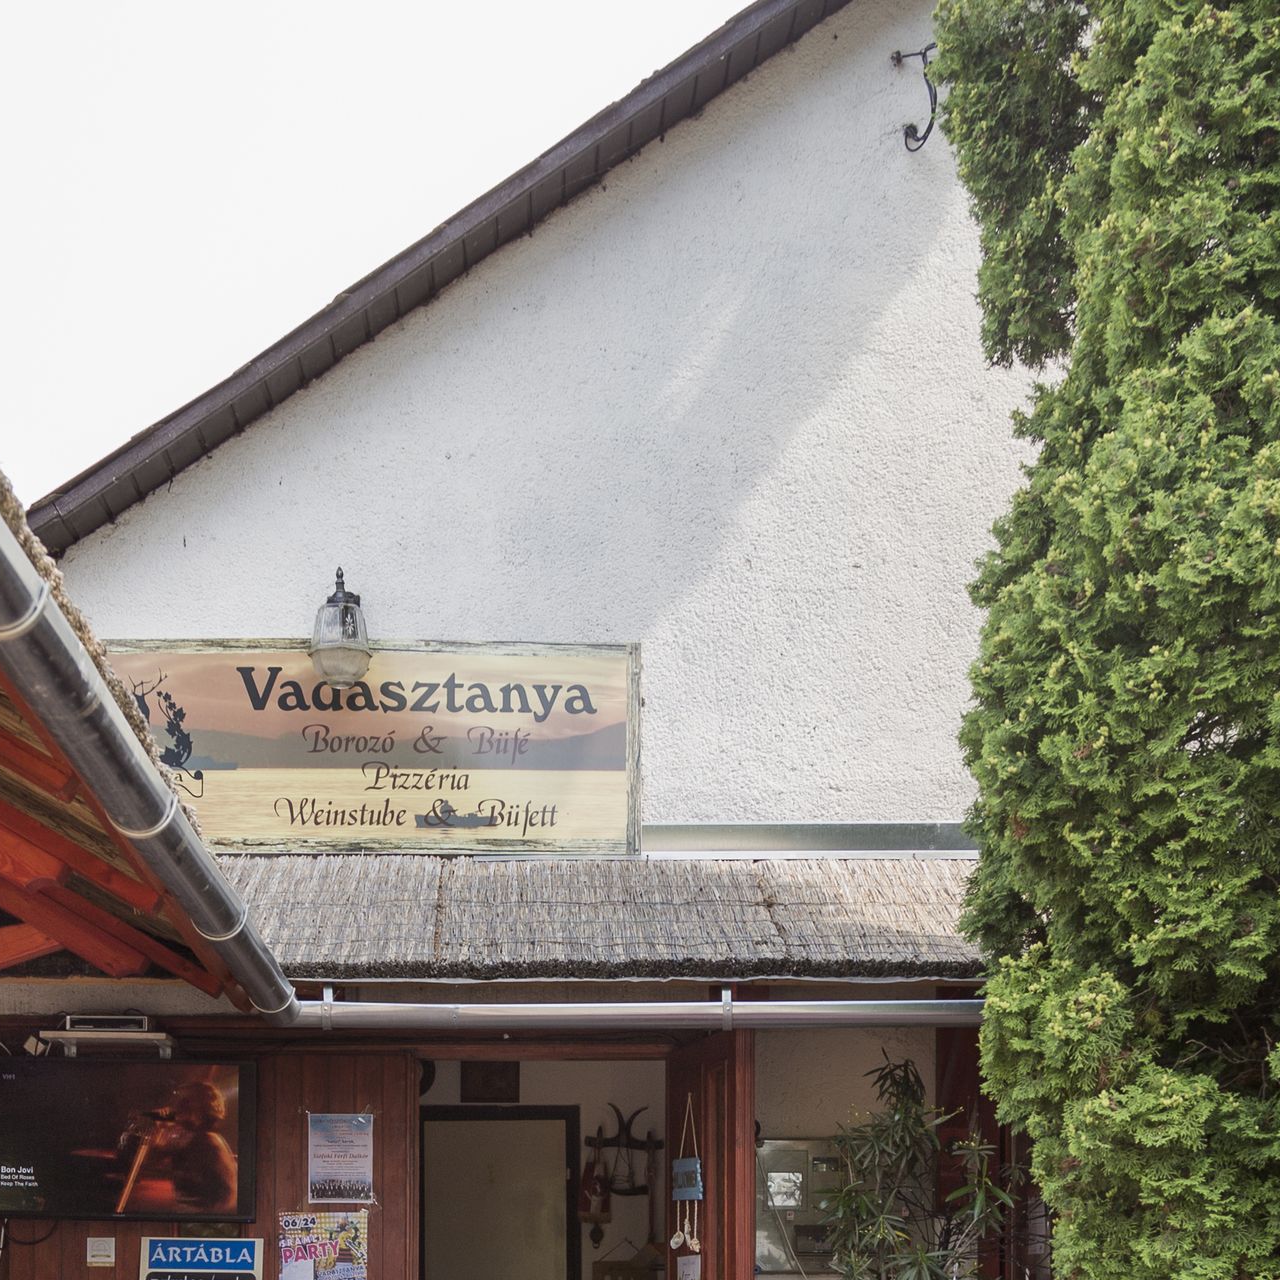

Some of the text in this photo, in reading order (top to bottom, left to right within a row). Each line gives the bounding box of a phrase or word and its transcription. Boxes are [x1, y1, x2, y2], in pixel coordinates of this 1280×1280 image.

[301, 723, 531, 765] Borozó & Büfé
[361, 760, 470, 791] Pizzéria
[274, 797, 558, 837] Weinstube & Büfett
[0, 1166, 34, 1174] Bon Jovi
[283, 1216, 317, 1229] 06/24
[151, 1242, 253, 1264] ÁRTÁBLA
[282, 1240, 340, 1263] PARTY
